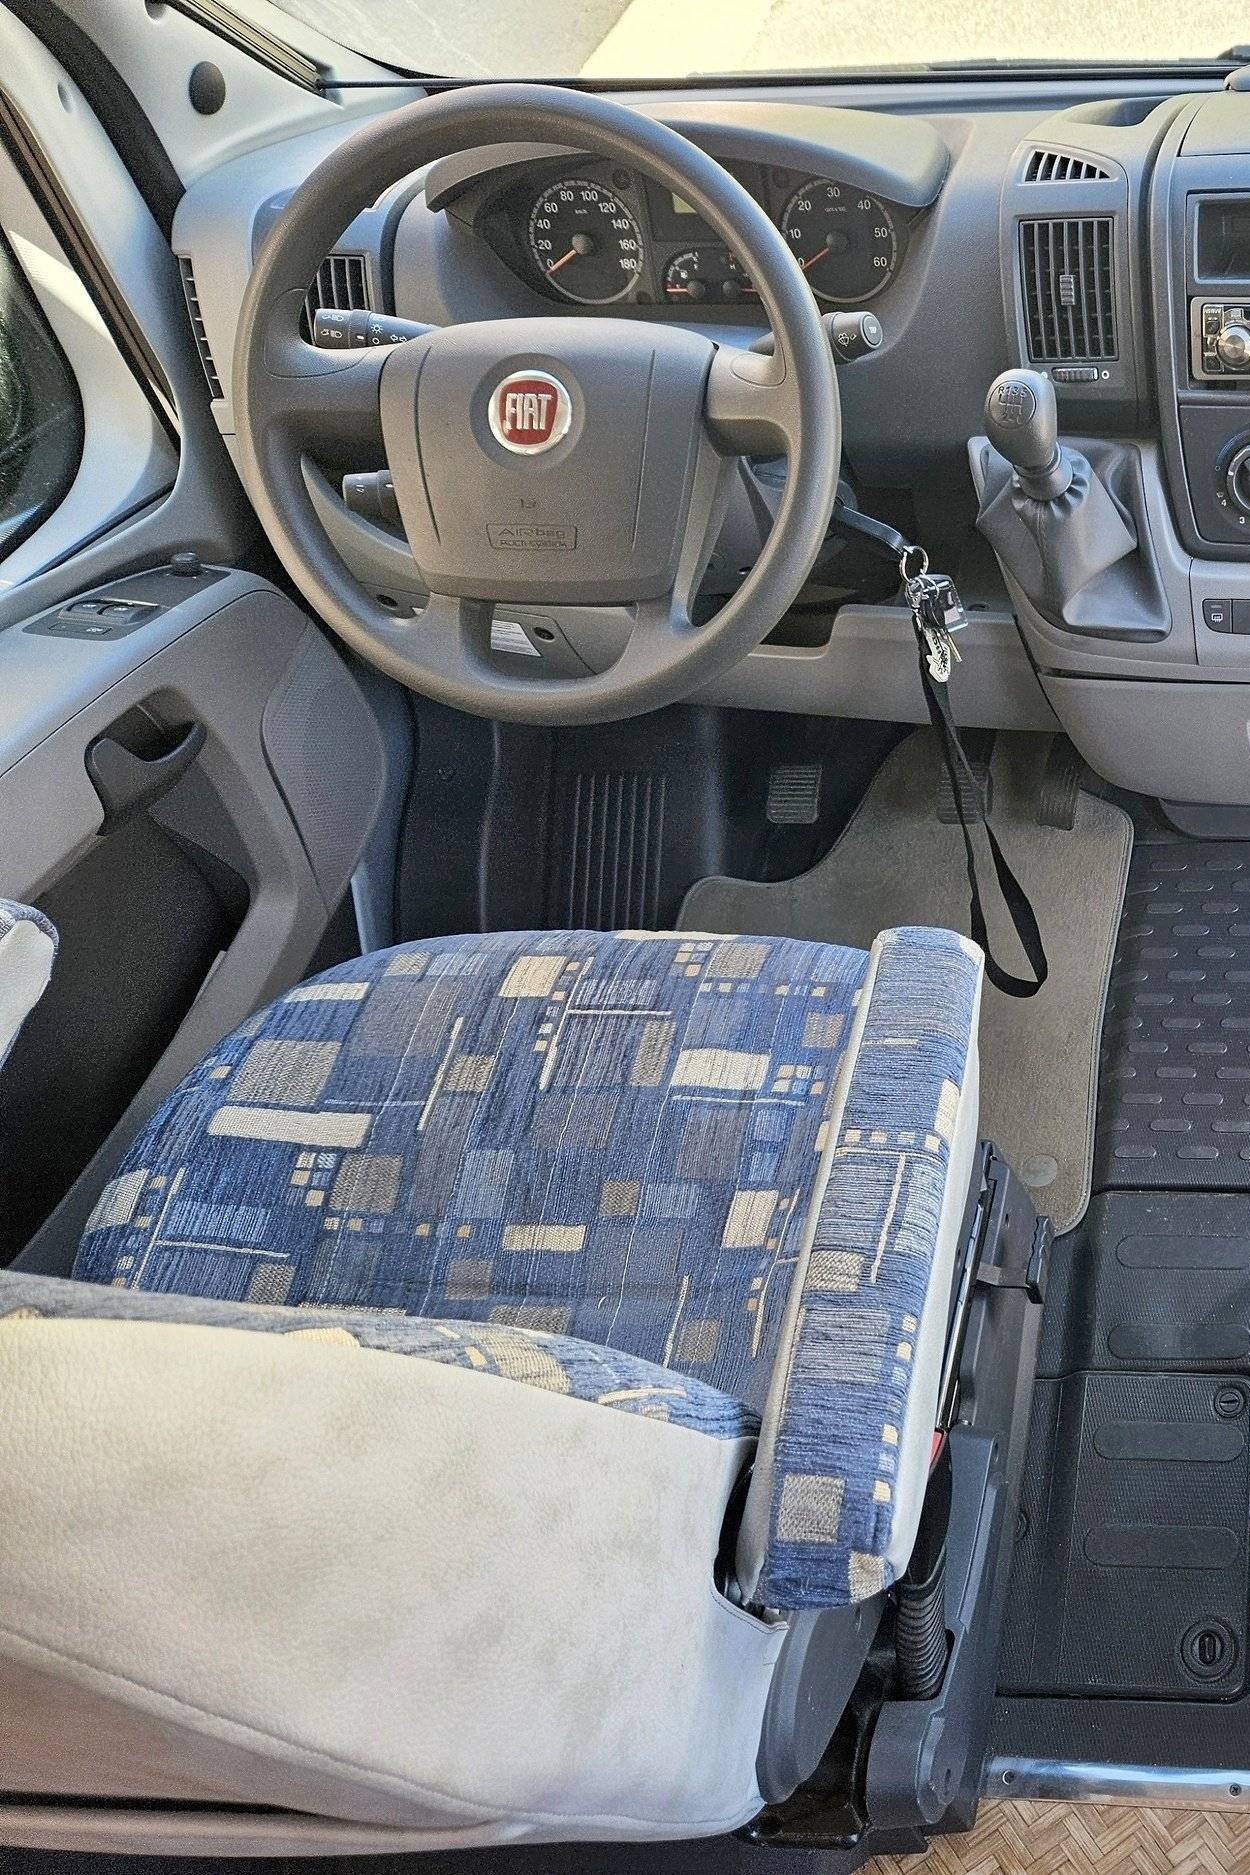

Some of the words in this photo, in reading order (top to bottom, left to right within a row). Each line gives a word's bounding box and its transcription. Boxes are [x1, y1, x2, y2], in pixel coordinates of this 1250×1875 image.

[560, 190, 574, 201] 80
[580, 190, 598, 201] 100
[827, 187, 840, 197] 30
[544, 202, 558, 213] 60
[599, 202, 616, 213] 120
[798, 200, 811, 211] 20
[857, 200, 871, 210] 40
[537, 219, 551, 229] 40
[611, 219, 630, 230] 140
[789, 228, 801, 239] 10
[874, 228, 887, 238] 50
[538, 240, 552, 250] 20
[619, 239, 636, 250] 160
[546, 259, 554, 268] 0
[619, 258, 637, 270] 180
[873, 257, 887, 267] 60
[504, 392, 553, 431] FIAT
[1221, 499, 1227, 507] 4
[1239, 516, 1245, 524] 3
